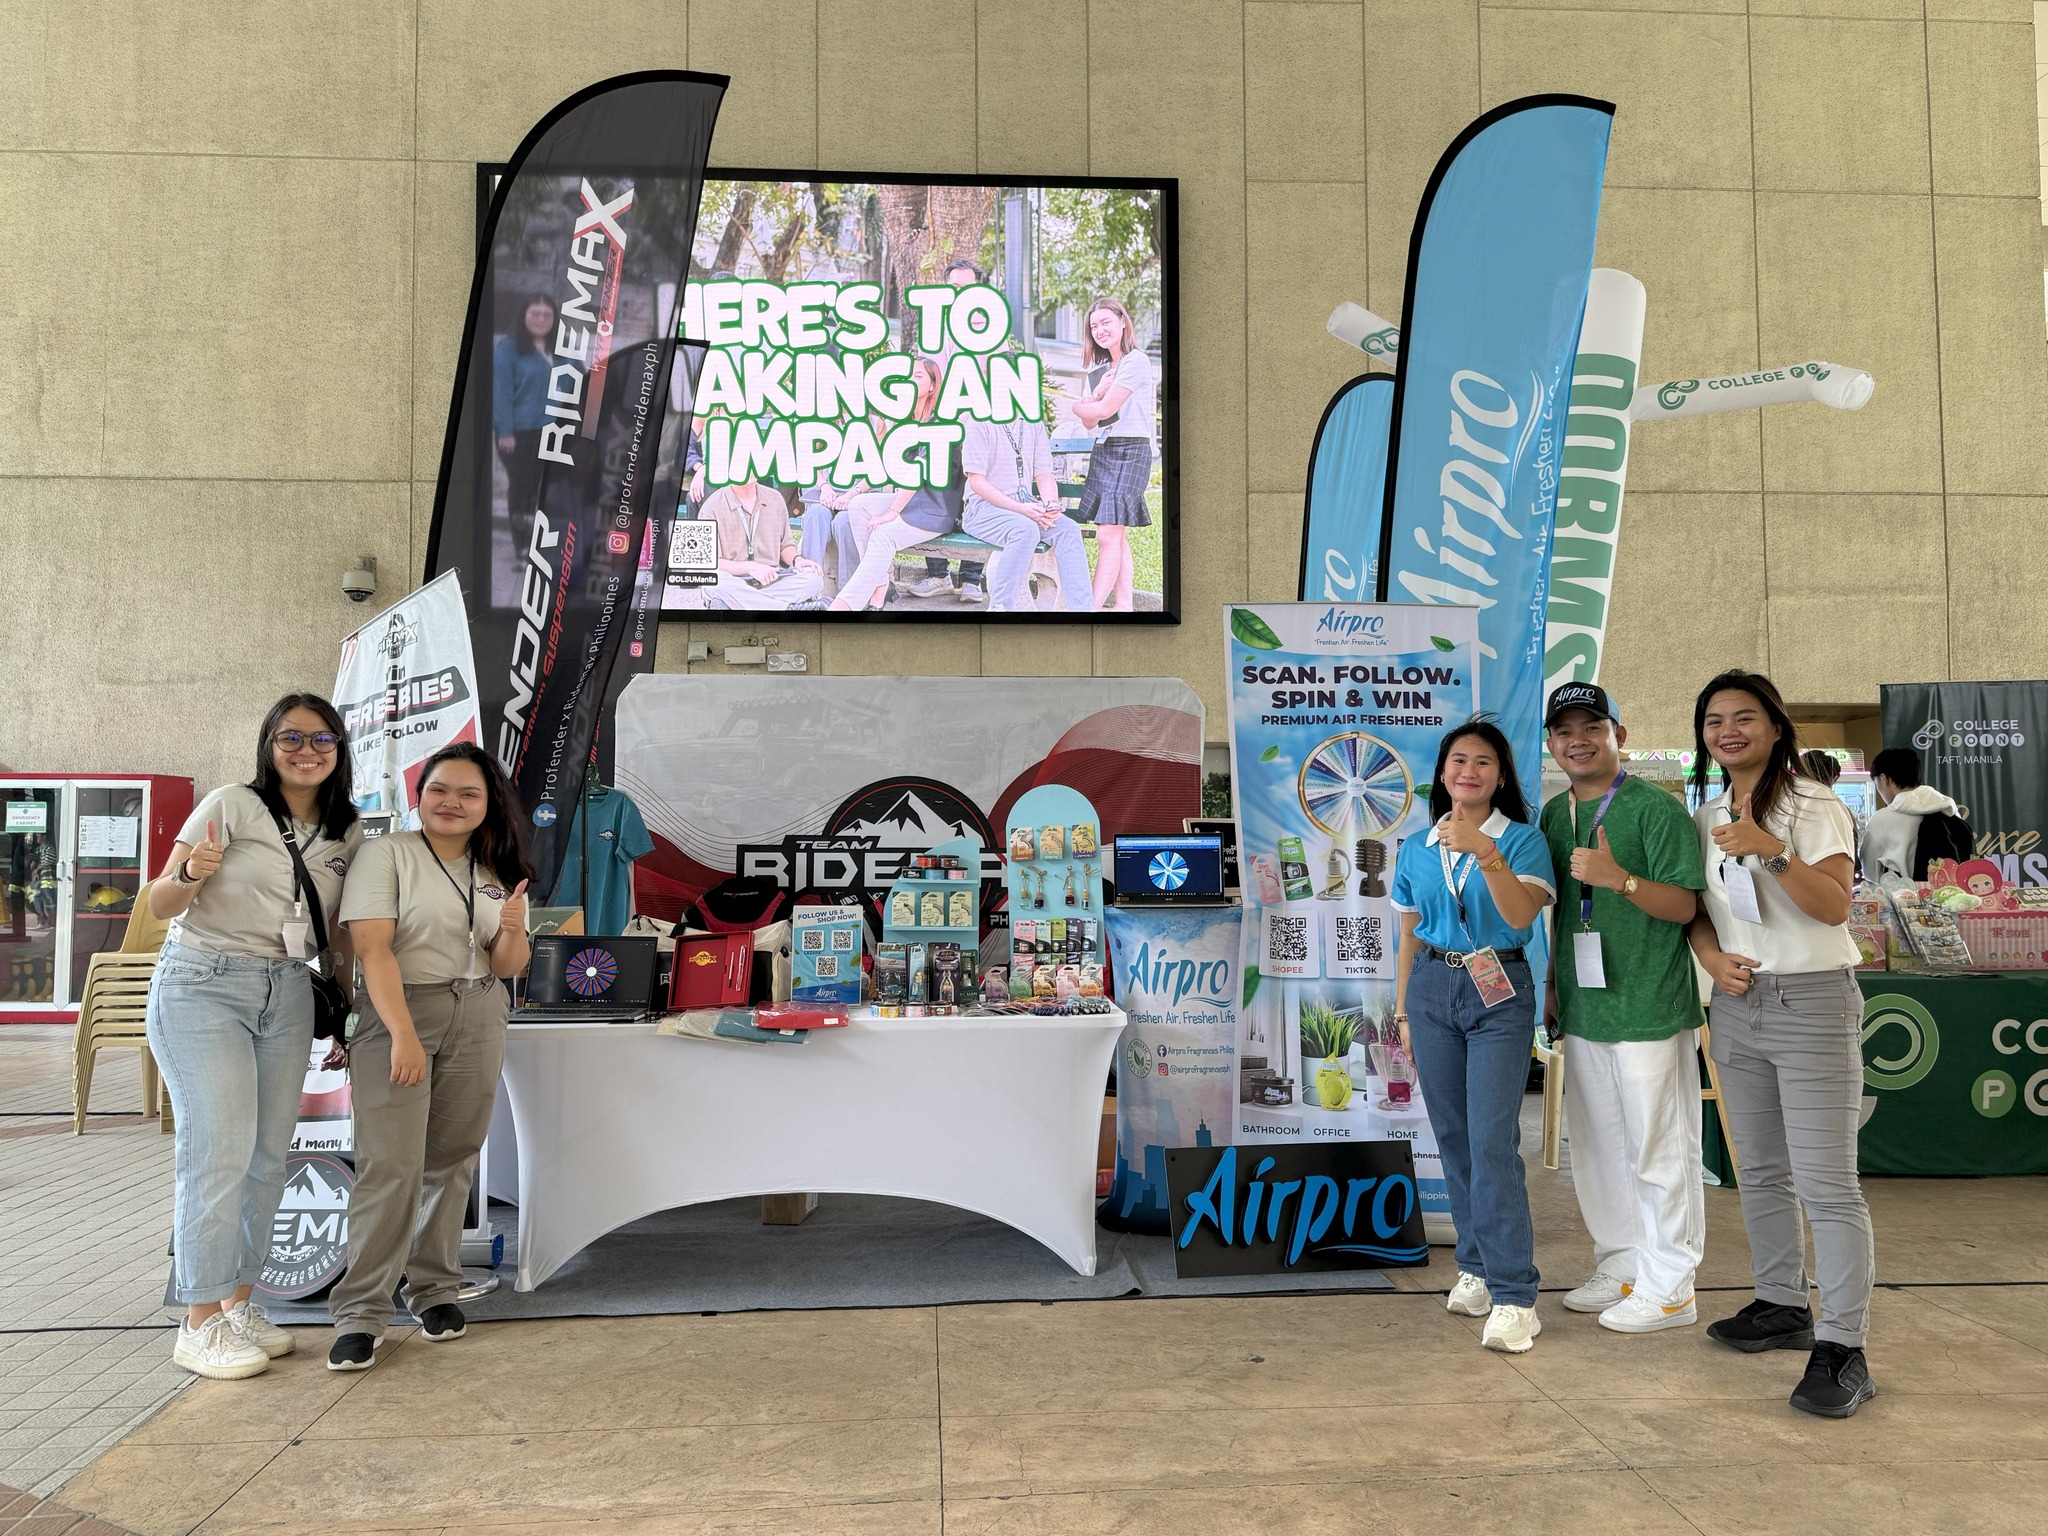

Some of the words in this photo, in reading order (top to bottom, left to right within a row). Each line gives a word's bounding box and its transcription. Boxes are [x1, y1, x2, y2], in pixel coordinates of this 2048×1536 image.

[538, 176, 634, 466] RIDEMAX
[907, 286, 1009, 353] TO
[672, 348, 925, 421] AKING
[939, 352, 1042, 424] AN
[1708, 371, 1785, 390] COLLEGE
[616, 342, 658, 529] @profenderxridemaxph
[705, 419, 966, 490] IMPACT
[1397, 369, 1523, 660] Airpro
[541, 522, 577, 678] Suspension
[1316, 607, 1385, 636] Airpro
[1242, 666, 1325, 685] SCAN.
[1333, 666, 1461, 687] FOLLOW.
[345, 672, 454, 730] FREEBIES
[1271, 690, 1336, 709] SPIN
[1344, 689, 1364, 708] &
[1372, 690, 1432, 709] WIN
[1553, 687, 1596, 705] Airpro
[540, 724, 569, 800] Profender
[563, 652, 598, 710] Ridemax
[1261, 714, 1328, 726] PREMIUM
[1332, 714, 1356, 725] AIR
[1360, 714, 1443, 726] FRESHENER
[1953, 719, 2019, 731] COLLEGE
[357, 736, 382, 755] LIKE
[1949, 732, 2025, 747] POINT
[1936, 755, 1962, 766] TAFT,
[1964, 755, 2003, 765] MANILA
[796, 840, 873, 850] TEAM
[798, 911, 828, 920] FOLLOW
[1128, 941, 1229, 1008] Airpro
[1272, 965, 1304, 974] SHOPEE
[1344, 966, 1378, 974] TIKTOK
[1183, 1010, 1218, 1024] Freshen
[1168, 1046, 1186, 1057] Airpro
[1242, 1124, 1300, 1135] BATHROOM
[1313, 1128, 1351, 1137] OFFICE
[1387, 1130, 1419, 1139] HOME
[305, 1137, 342, 1151] many
[1177, 1146, 1415, 1267] Airpro
